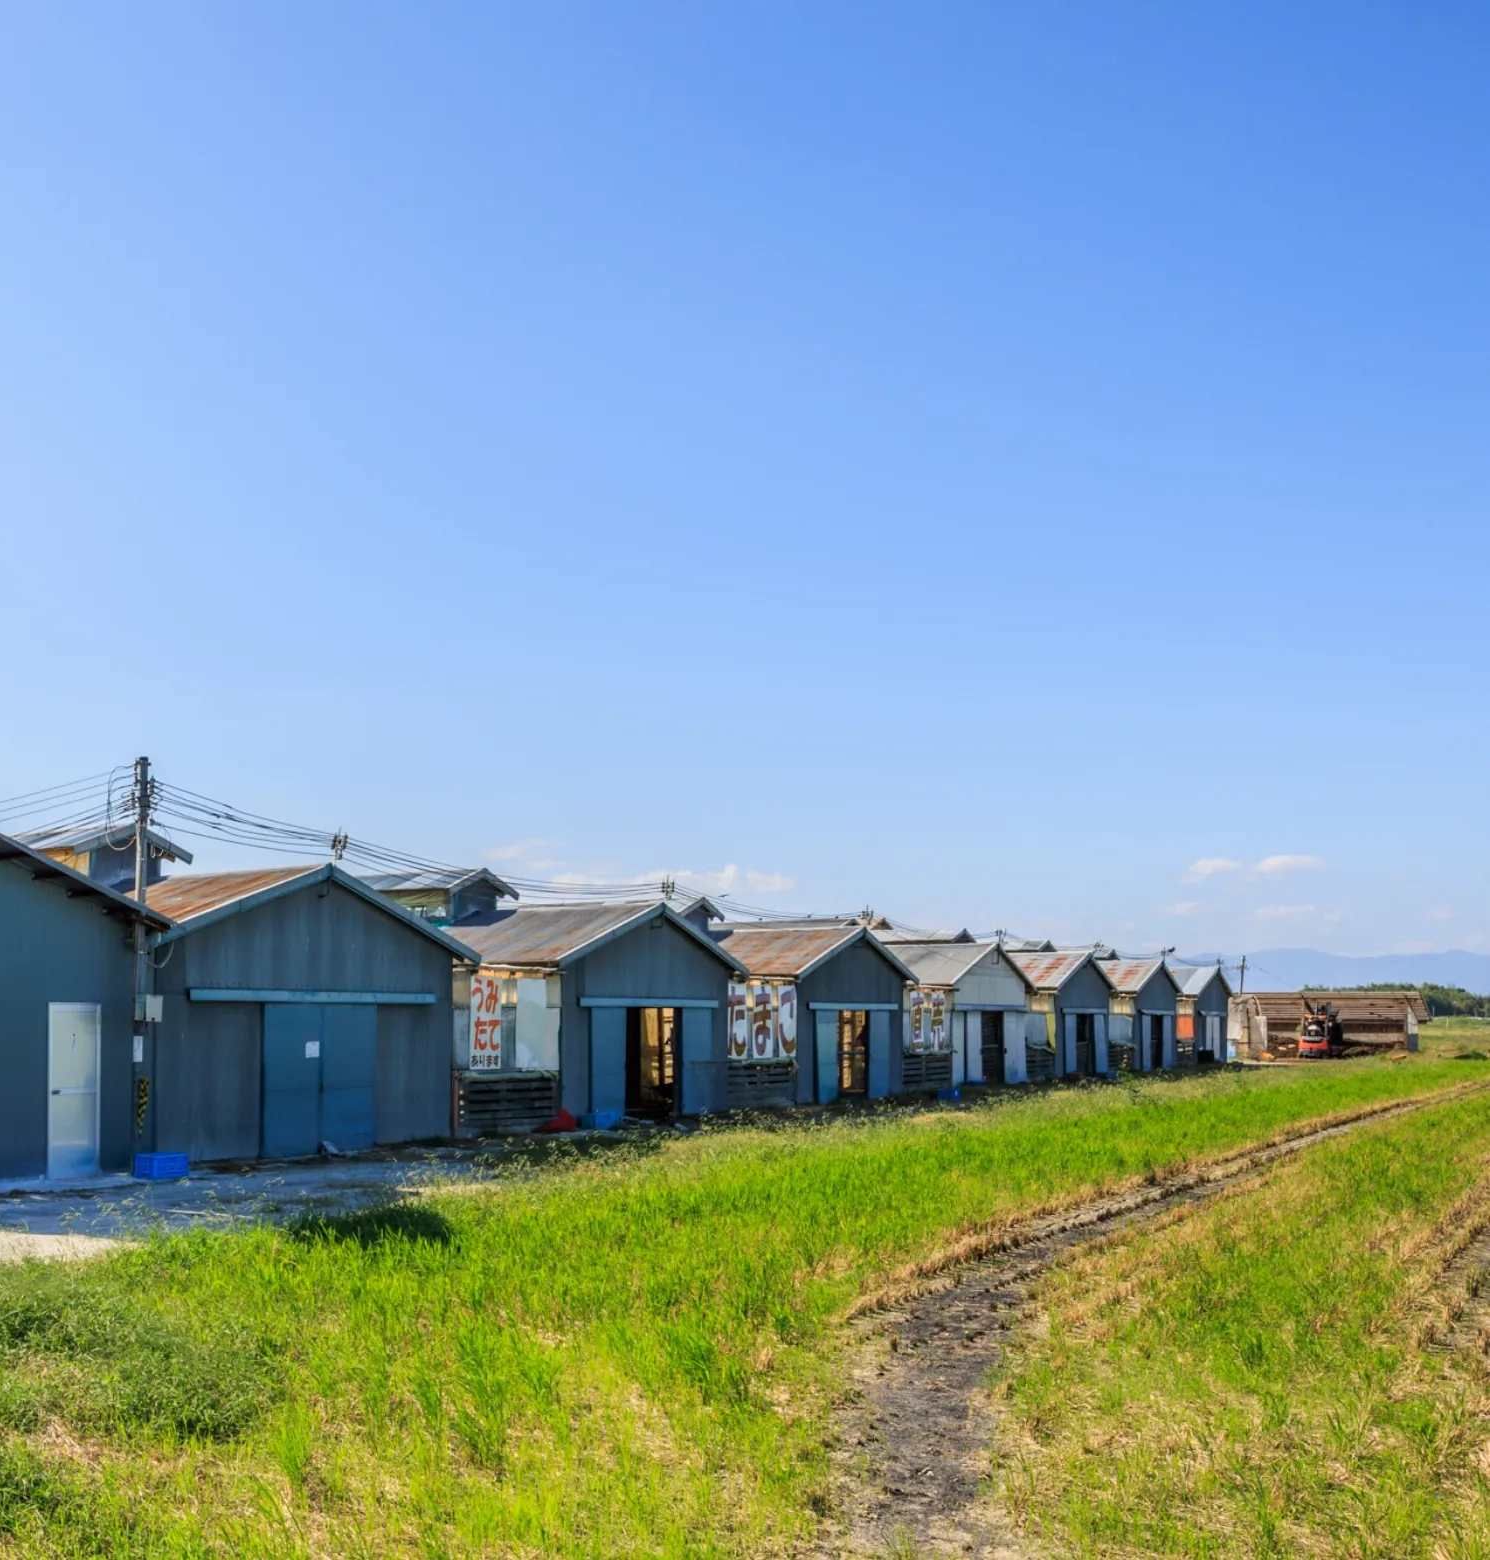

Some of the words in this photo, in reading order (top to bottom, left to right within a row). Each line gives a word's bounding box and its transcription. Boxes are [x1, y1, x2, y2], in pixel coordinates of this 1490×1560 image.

[472, 978, 499, 1014] うみ
[474, 1017, 500, 1051] たて
[471, 1055, 499, 1067] あります
